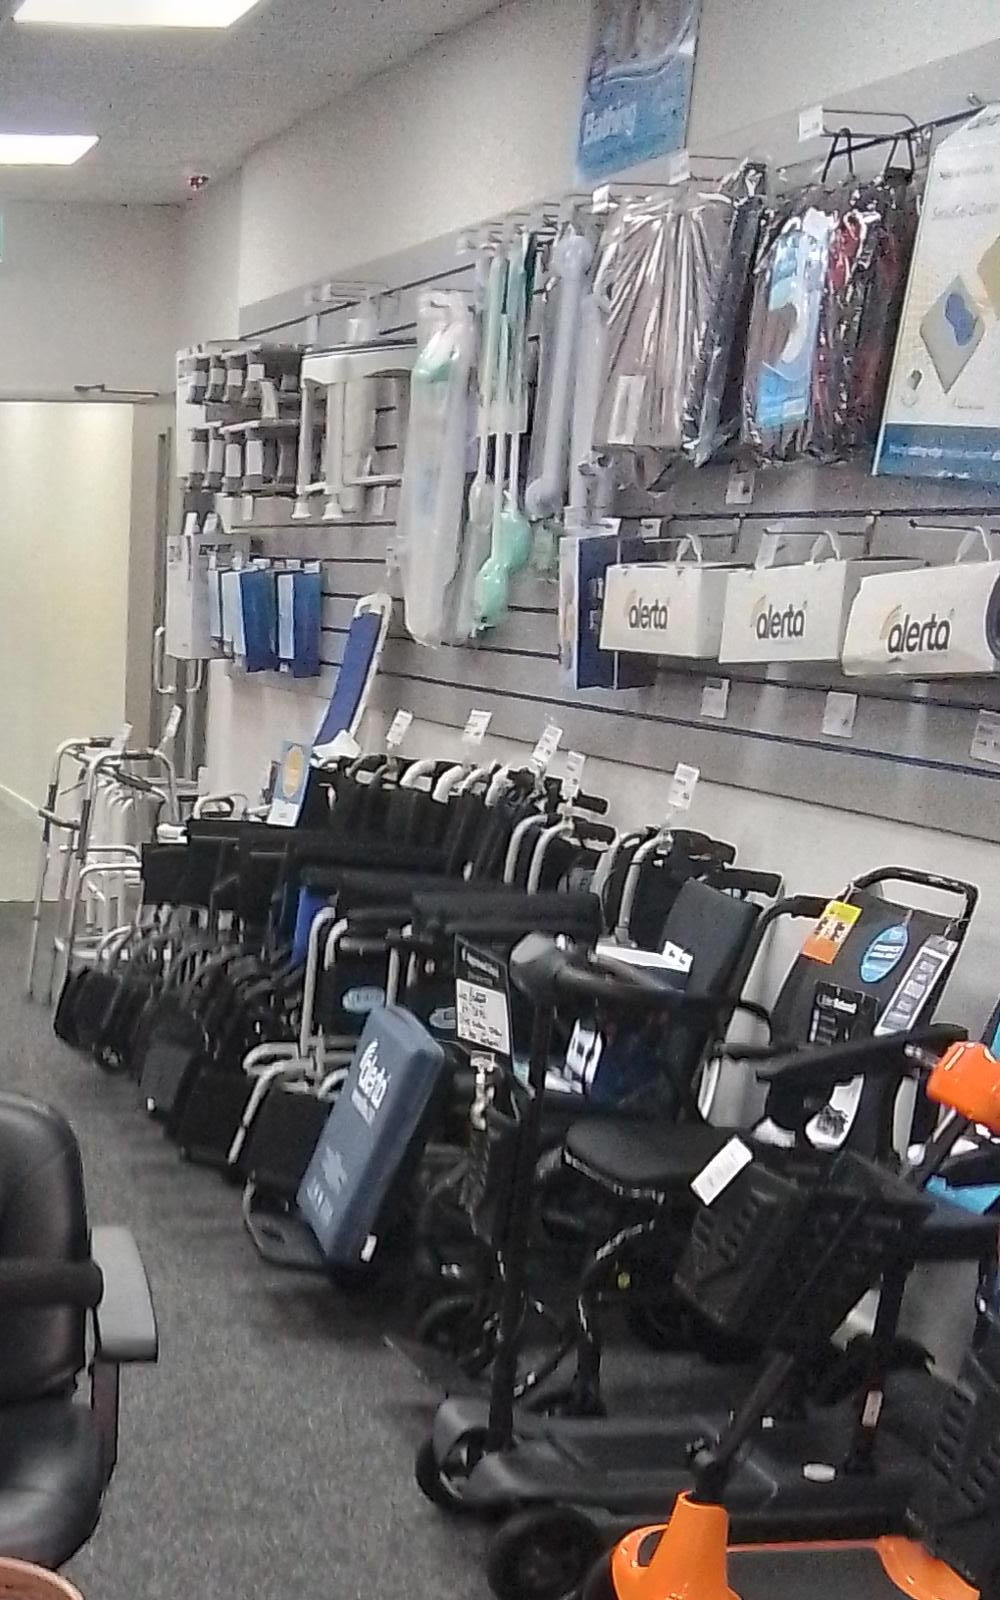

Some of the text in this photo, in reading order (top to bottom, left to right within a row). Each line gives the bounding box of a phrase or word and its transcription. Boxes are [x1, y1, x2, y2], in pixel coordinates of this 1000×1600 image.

[629, 598, 668, 630] alerta
[756, 604, 805, 640] alerta
[888, 614, 951, 653] alerta
